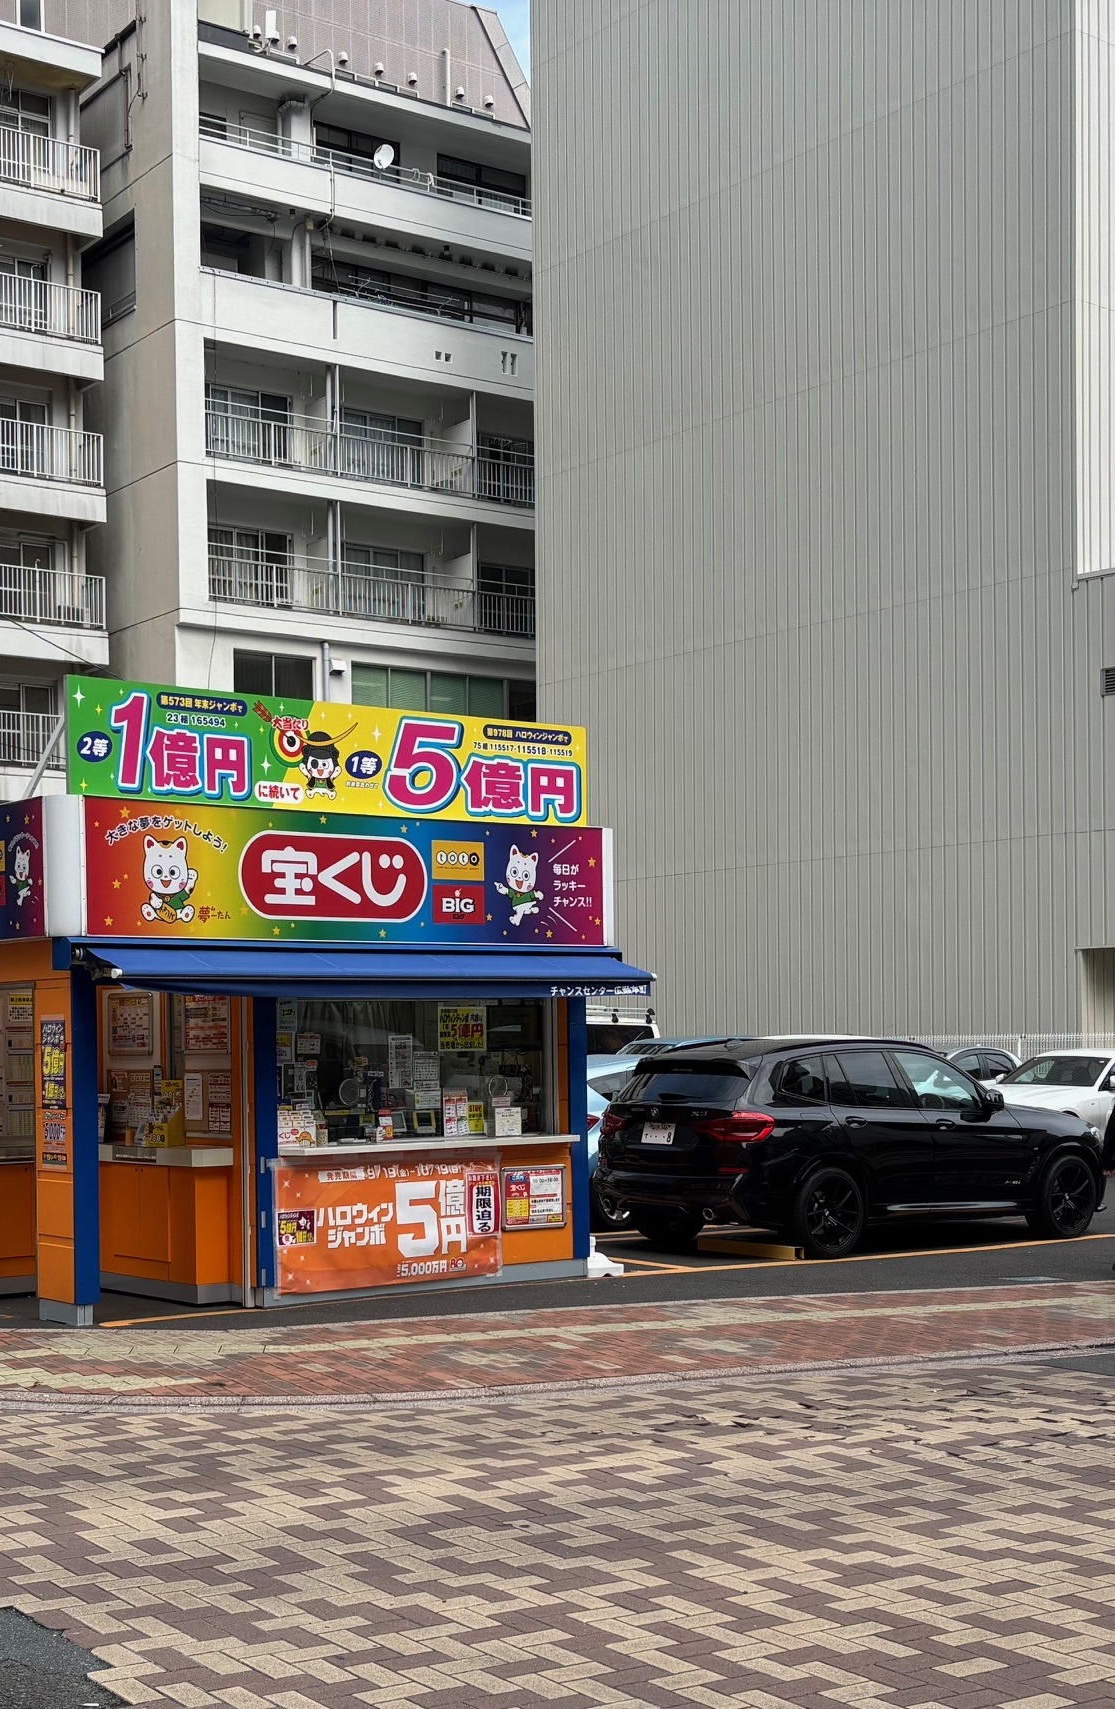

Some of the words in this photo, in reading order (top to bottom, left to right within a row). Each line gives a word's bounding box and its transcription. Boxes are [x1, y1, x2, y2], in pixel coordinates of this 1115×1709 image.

[191, 716, 226, 728] 165494
[79, 737, 109, 757] 2等
[112, 693, 248, 796] 1億円
[350, 756, 377, 776] 1等
[386, 721, 577, 816] 5億円
[258, 785, 301, 801] に続いて
[436, 850, 480, 867] toto
[261, 845, 408, 907] 宝くじ
[552, 864, 579, 876] 毎日が
[553, 880, 586, 892] ラッキー
[442, 896, 475, 913] BIG
[553, 896, 592, 908] チャンス!!
[451, 1023, 484, 1039] 5億円
[318, 1202, 394, 1227] ハロウィン
[394, 1179, 468, 1258] 5億円
[475, 1185, 493, 1233] 期限迫る
[327, 1224, 386, 1249] ジャンボ
